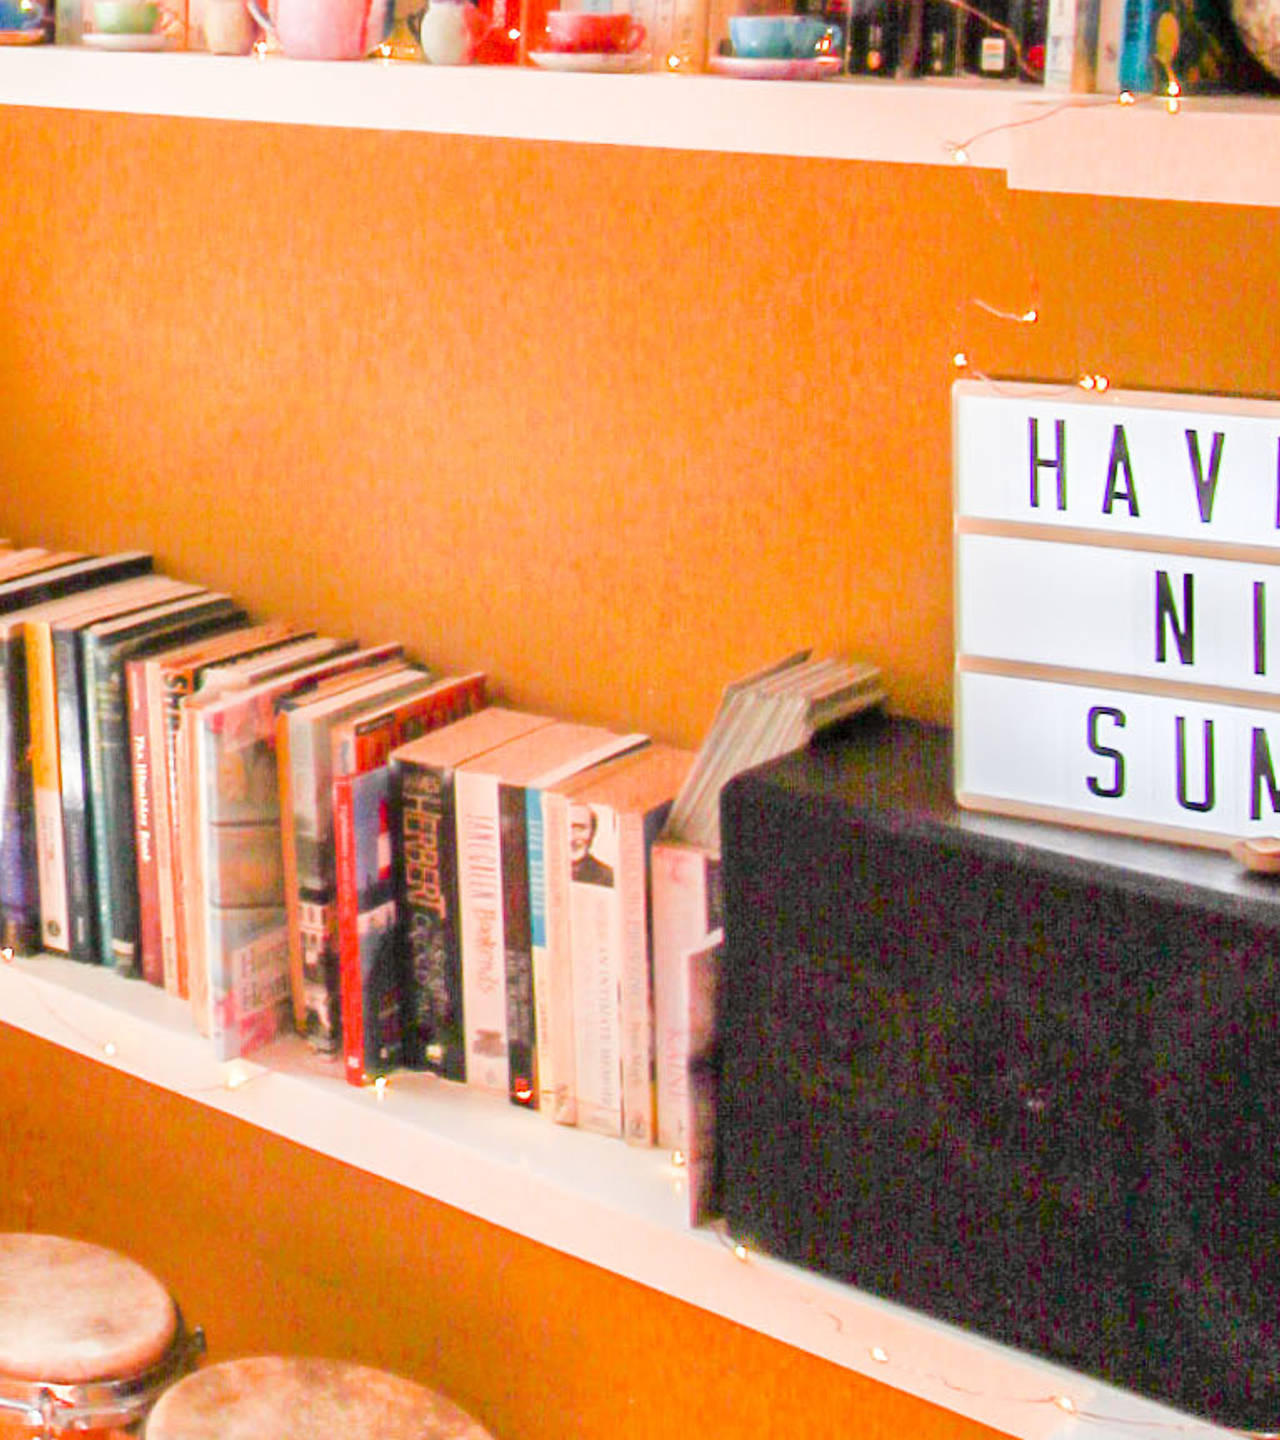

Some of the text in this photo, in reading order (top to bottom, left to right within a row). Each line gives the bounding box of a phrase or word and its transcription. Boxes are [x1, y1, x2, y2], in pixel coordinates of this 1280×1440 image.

[1028, 417, 1280, 528] HAV
[134, 735, 146, 759] The
[403, 794, 446, 920] HERBERT
